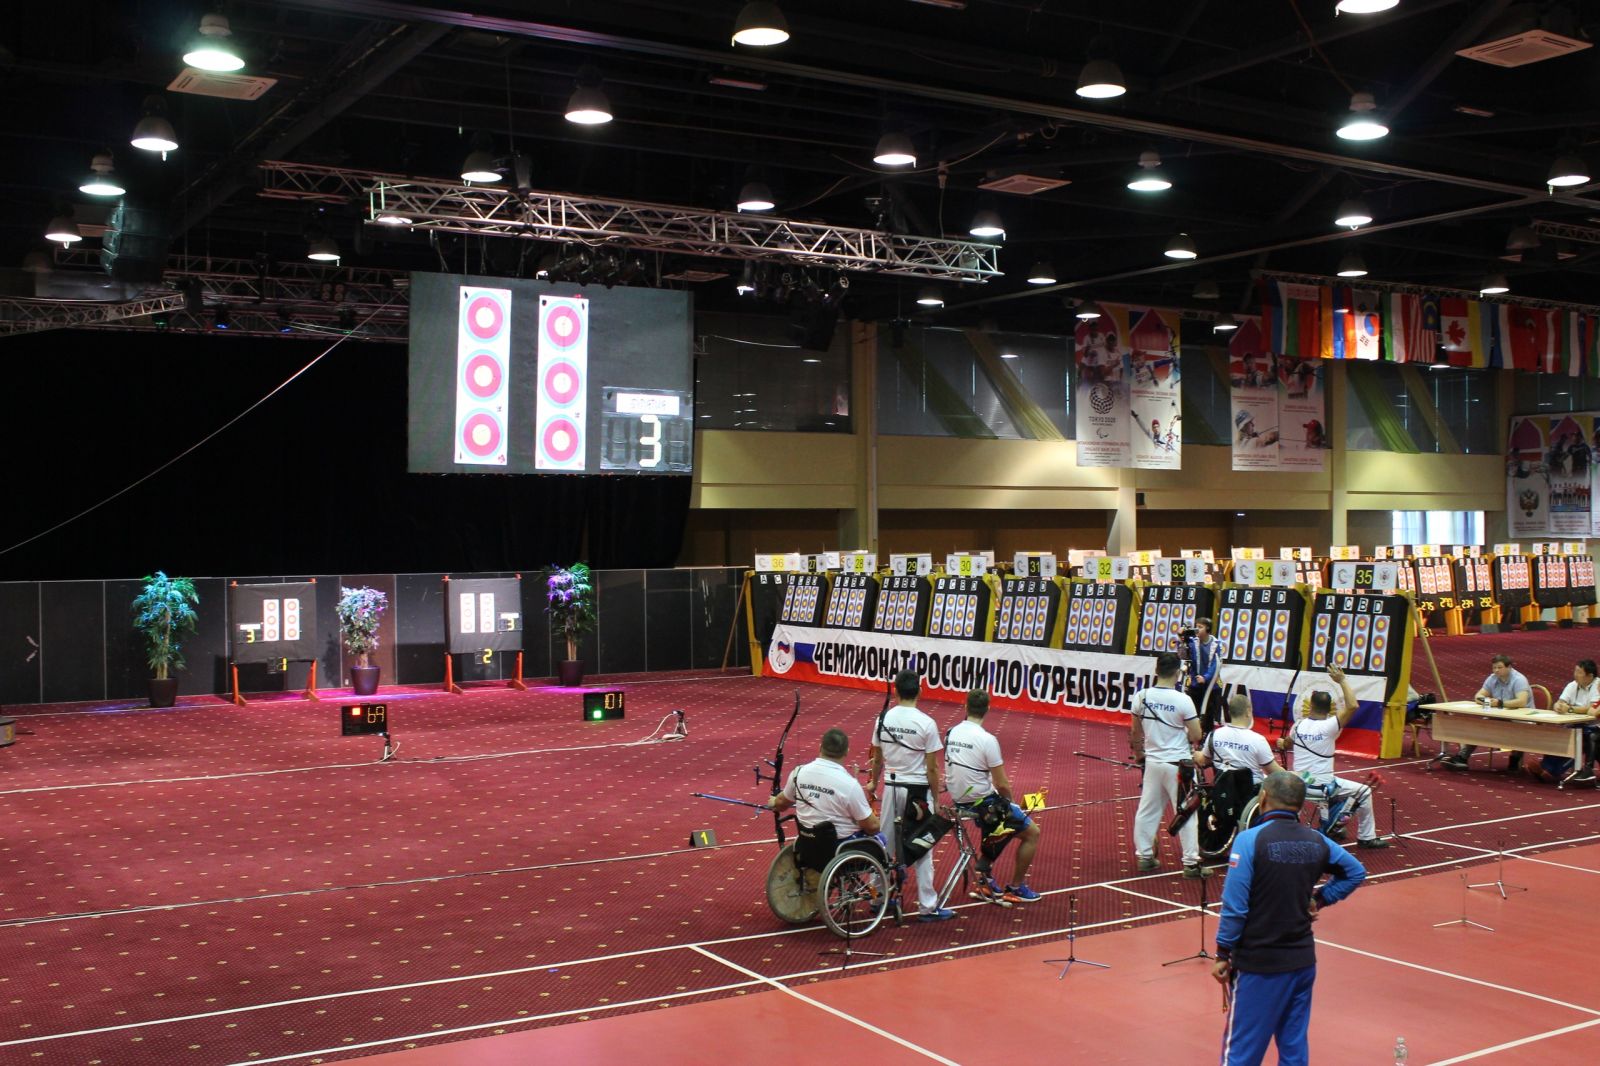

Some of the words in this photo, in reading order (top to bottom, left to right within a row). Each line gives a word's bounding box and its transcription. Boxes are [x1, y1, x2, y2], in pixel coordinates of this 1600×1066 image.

[639, 414, 661, 468] 3
[771, 558, 784, 568] 36
[808, 560, 816, 568] 27
[907, 561, 917, 572] 29
[961, 560, 971, 572] 30
[1030, 561, 1040, 573] 31
[1100, 563, 1111, 575] 32
[1172, 564, 1186, 577] 33
[1257, 566, 1273, 580] 34
[1356, 570, 1373, 584] 35
[1327, 597, 1335, 609] A
[1345, 598, 1352, 609] C
[1359, 599, 1367, 611] B
[1374, 601, 1382, 612] D
[507, 618, 514, 631] 3
[246, 629, 255, 643] 3
[483, 648, 492, 664] 2
[282, 657, 287, 671] 1
[814, 641, 910, 681] ЧЕМПИОНАТ
[917, 651, 989, 691] РОССИИ
[995, 659, 1022, 696] ПО
[1029, 664, 1136, 711] СТРЕЛЬБЕ
[1214, 740, 1250, 751] БУРЯТИЯ
[1031, 796, 1038, 807] 2
[700, 831, 708, 845] 1
